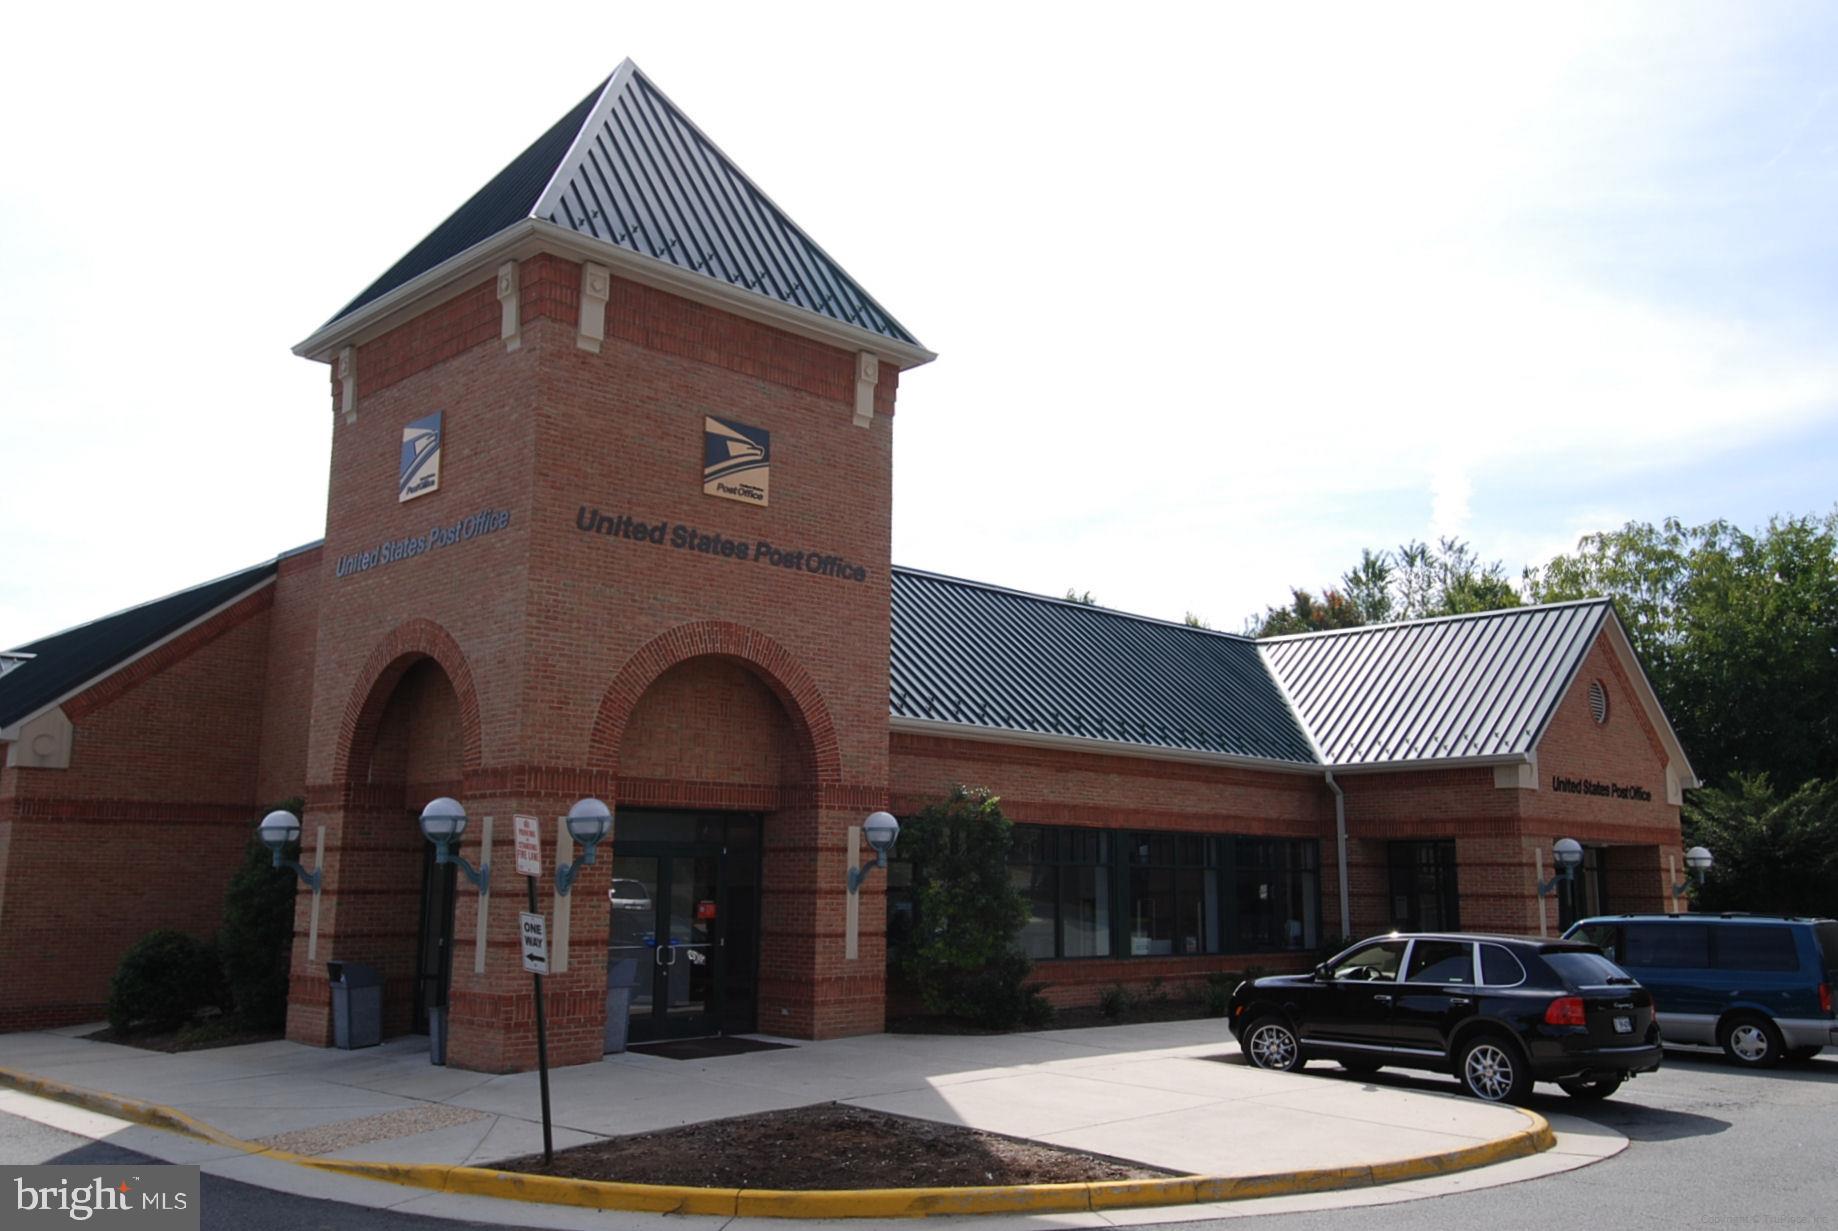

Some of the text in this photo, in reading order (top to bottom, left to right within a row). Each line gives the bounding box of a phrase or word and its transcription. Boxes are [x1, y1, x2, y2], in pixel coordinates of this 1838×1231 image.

[716, 482, 737, 495] Post
[738, 487, 764, 501] Office
[336, 509, 510, 577] United States Post Office
[576, 505, 867, 583] United States Post Office
[1552, 775, 1652, 802] United States Post Office
[524, 922, 543, 935] ONE
[524, 936, 544, 949] WAY
